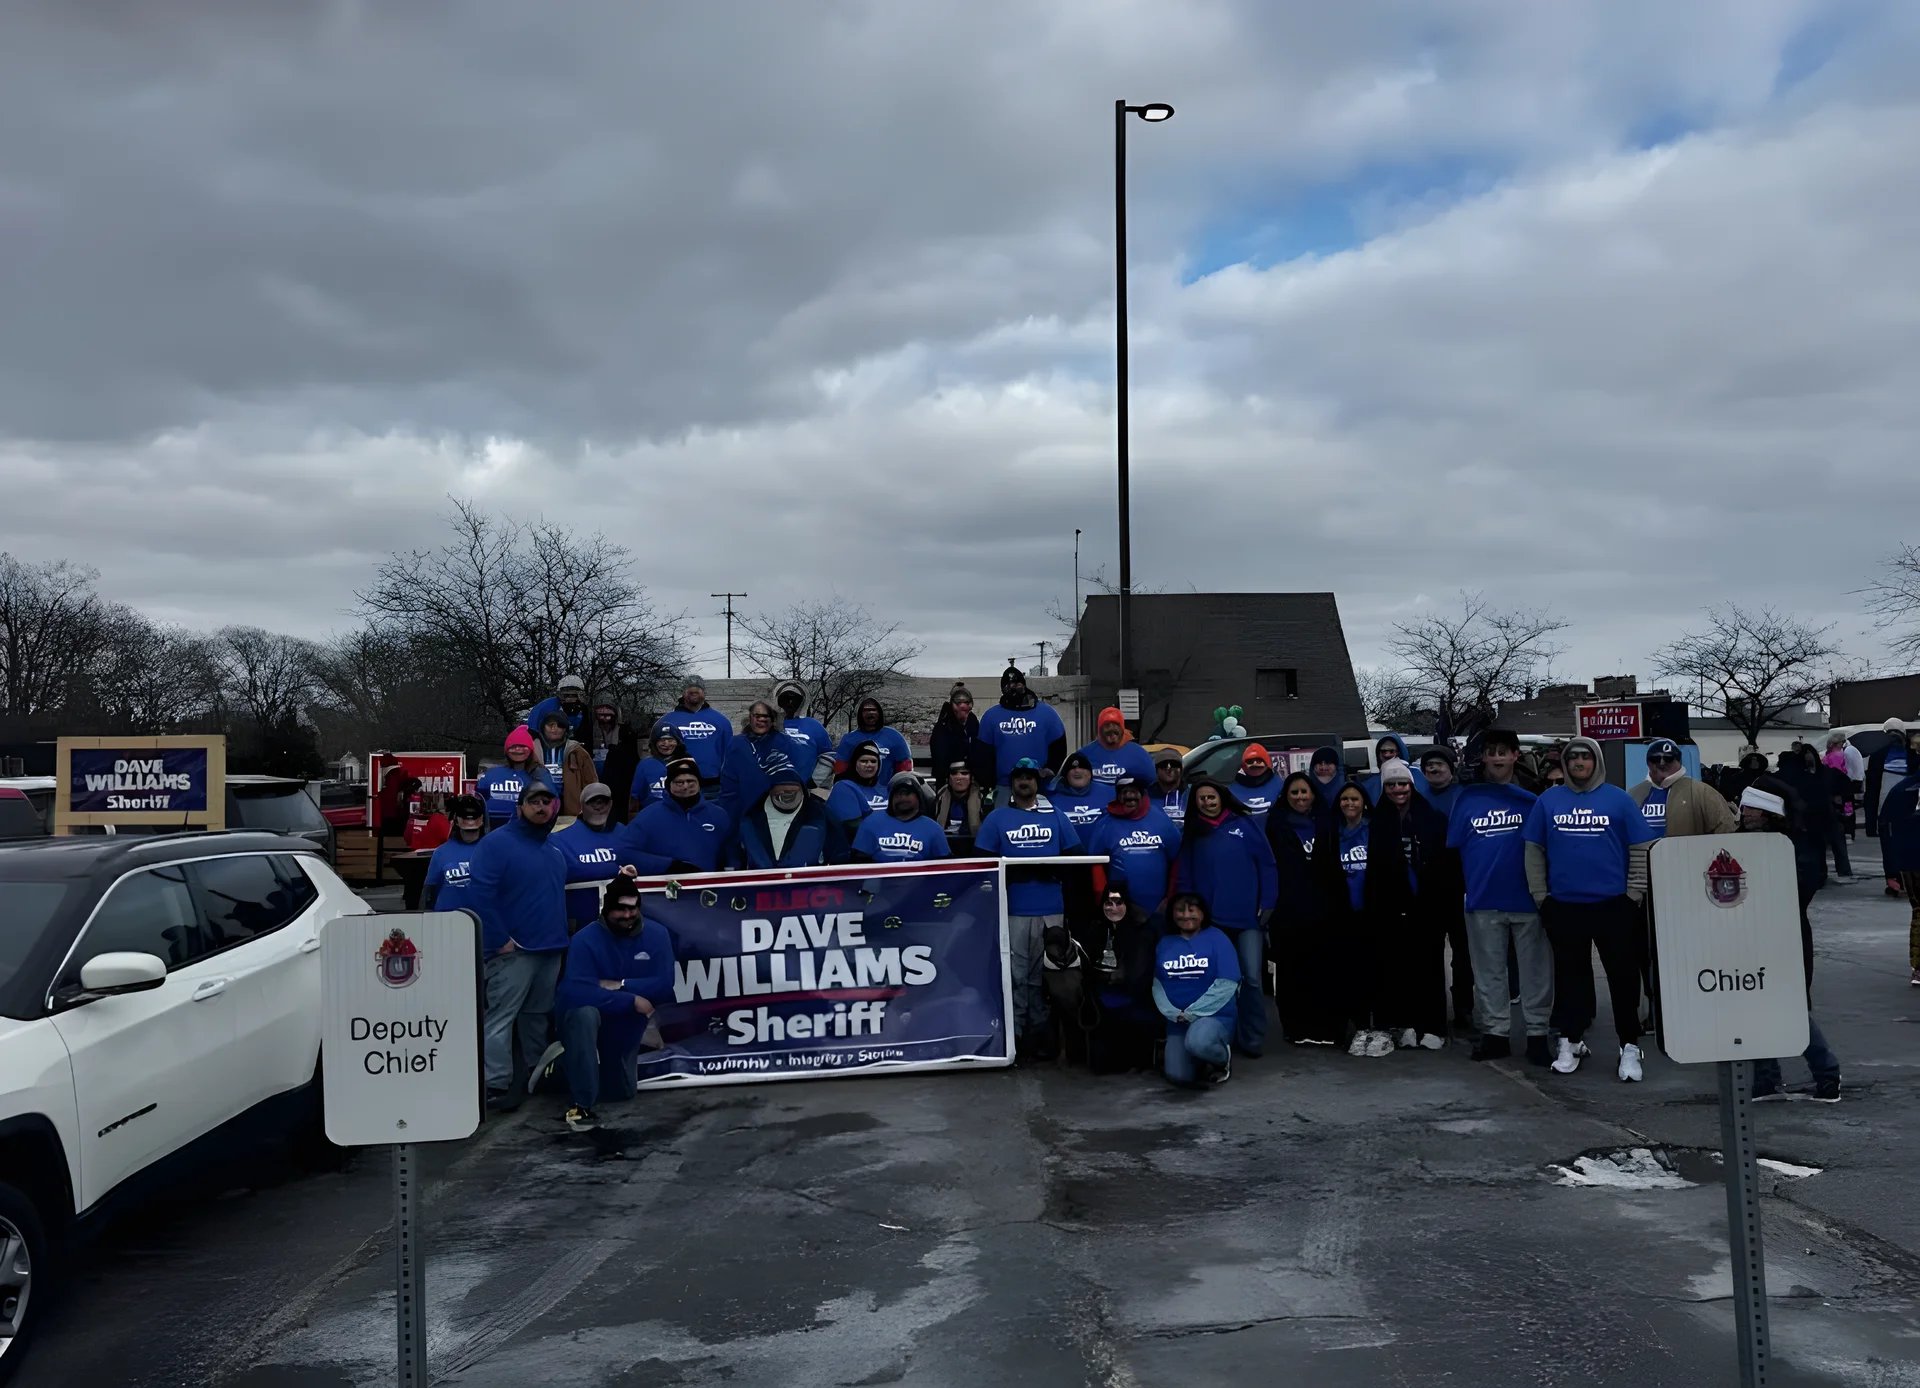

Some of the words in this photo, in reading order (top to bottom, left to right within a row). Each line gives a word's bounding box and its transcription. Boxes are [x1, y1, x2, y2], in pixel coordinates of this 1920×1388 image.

[114, 759, 164, 774] DAVE
[85, 773, 191, 791] WILLIAMS
[741, 911, 867, 953] DAVE
[673, 945, 937, 1003] WILLIAMS
[1697, 966, 1766, 993] Chief
[350, 1015, 449, 1045] Deputy
[727, 1001, 887, 1046] Sheriff
[363, 1048, 439, 1075] Chief
